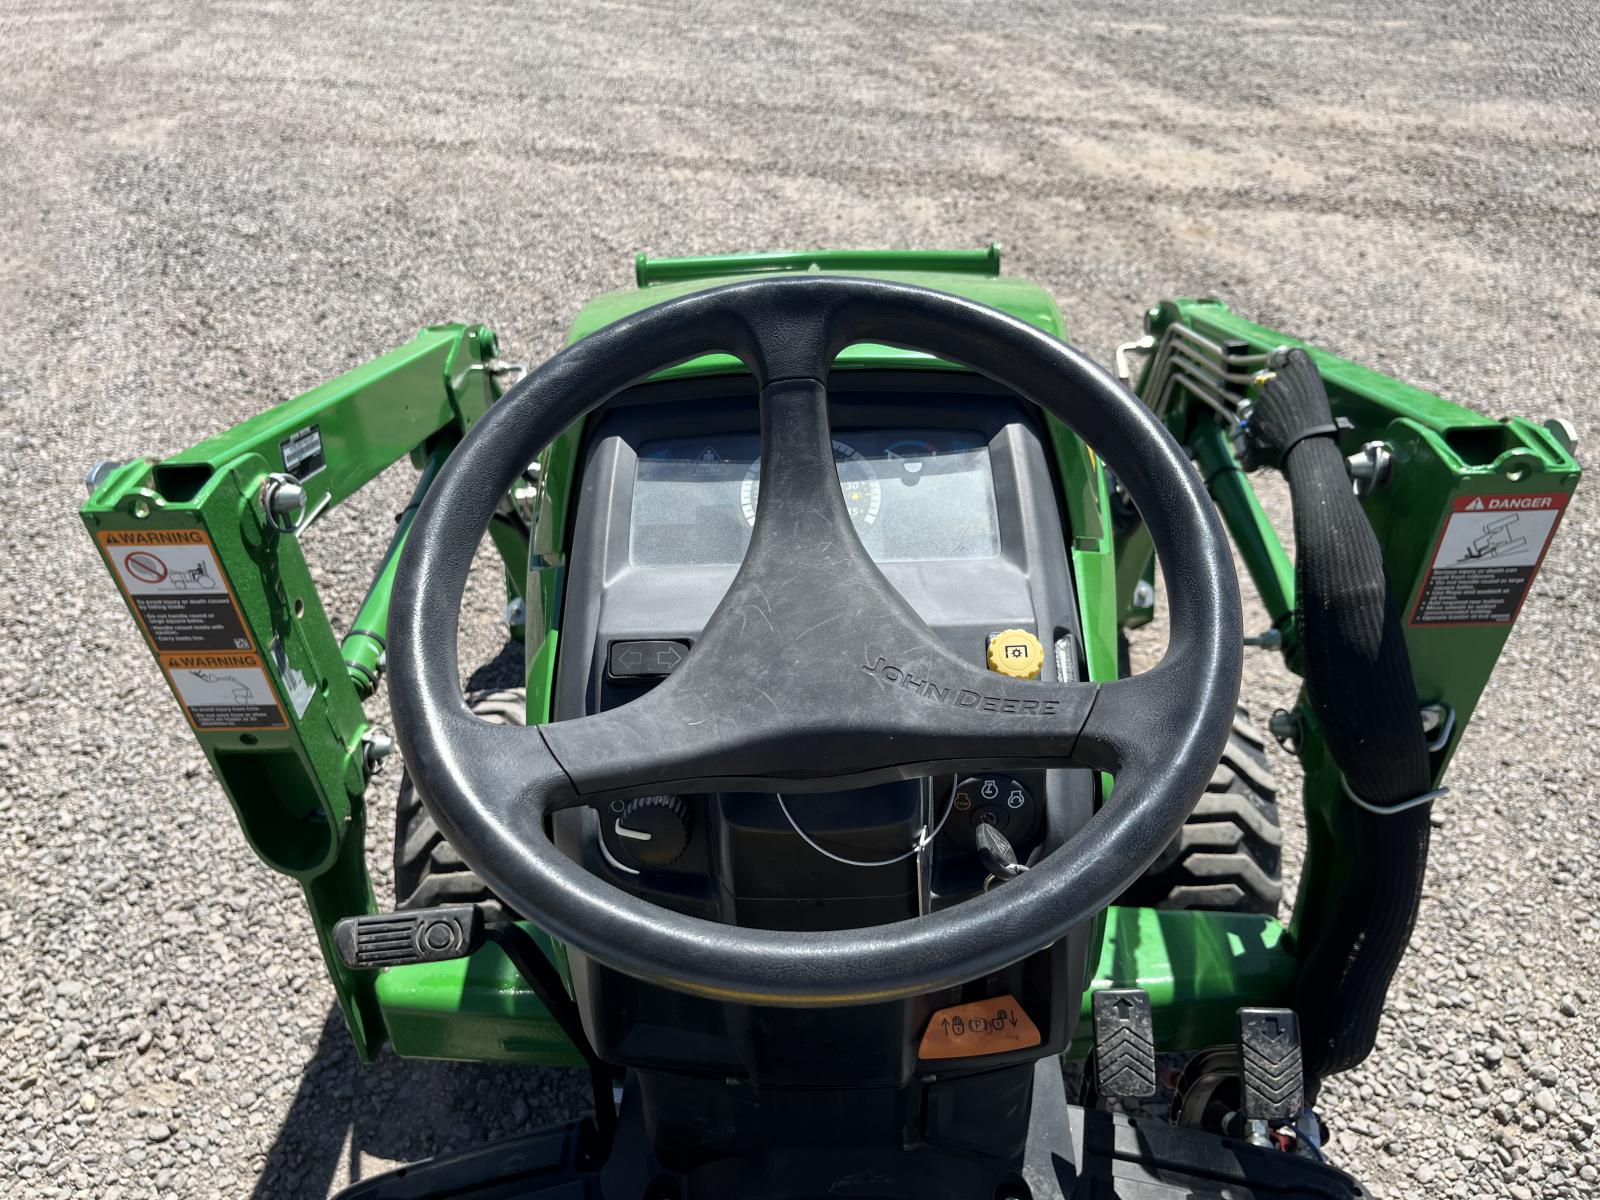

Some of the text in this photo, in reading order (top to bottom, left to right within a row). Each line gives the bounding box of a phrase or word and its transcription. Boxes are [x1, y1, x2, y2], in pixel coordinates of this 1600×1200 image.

[845, 481, 859, 490] 30
[1488, 497, 1552, 509] DANGER
[119, 531, 203, 544] WARNING
[180, 656, 257, 667] WARNING
[863, 657, 1060, 715] JOHN DEERE
